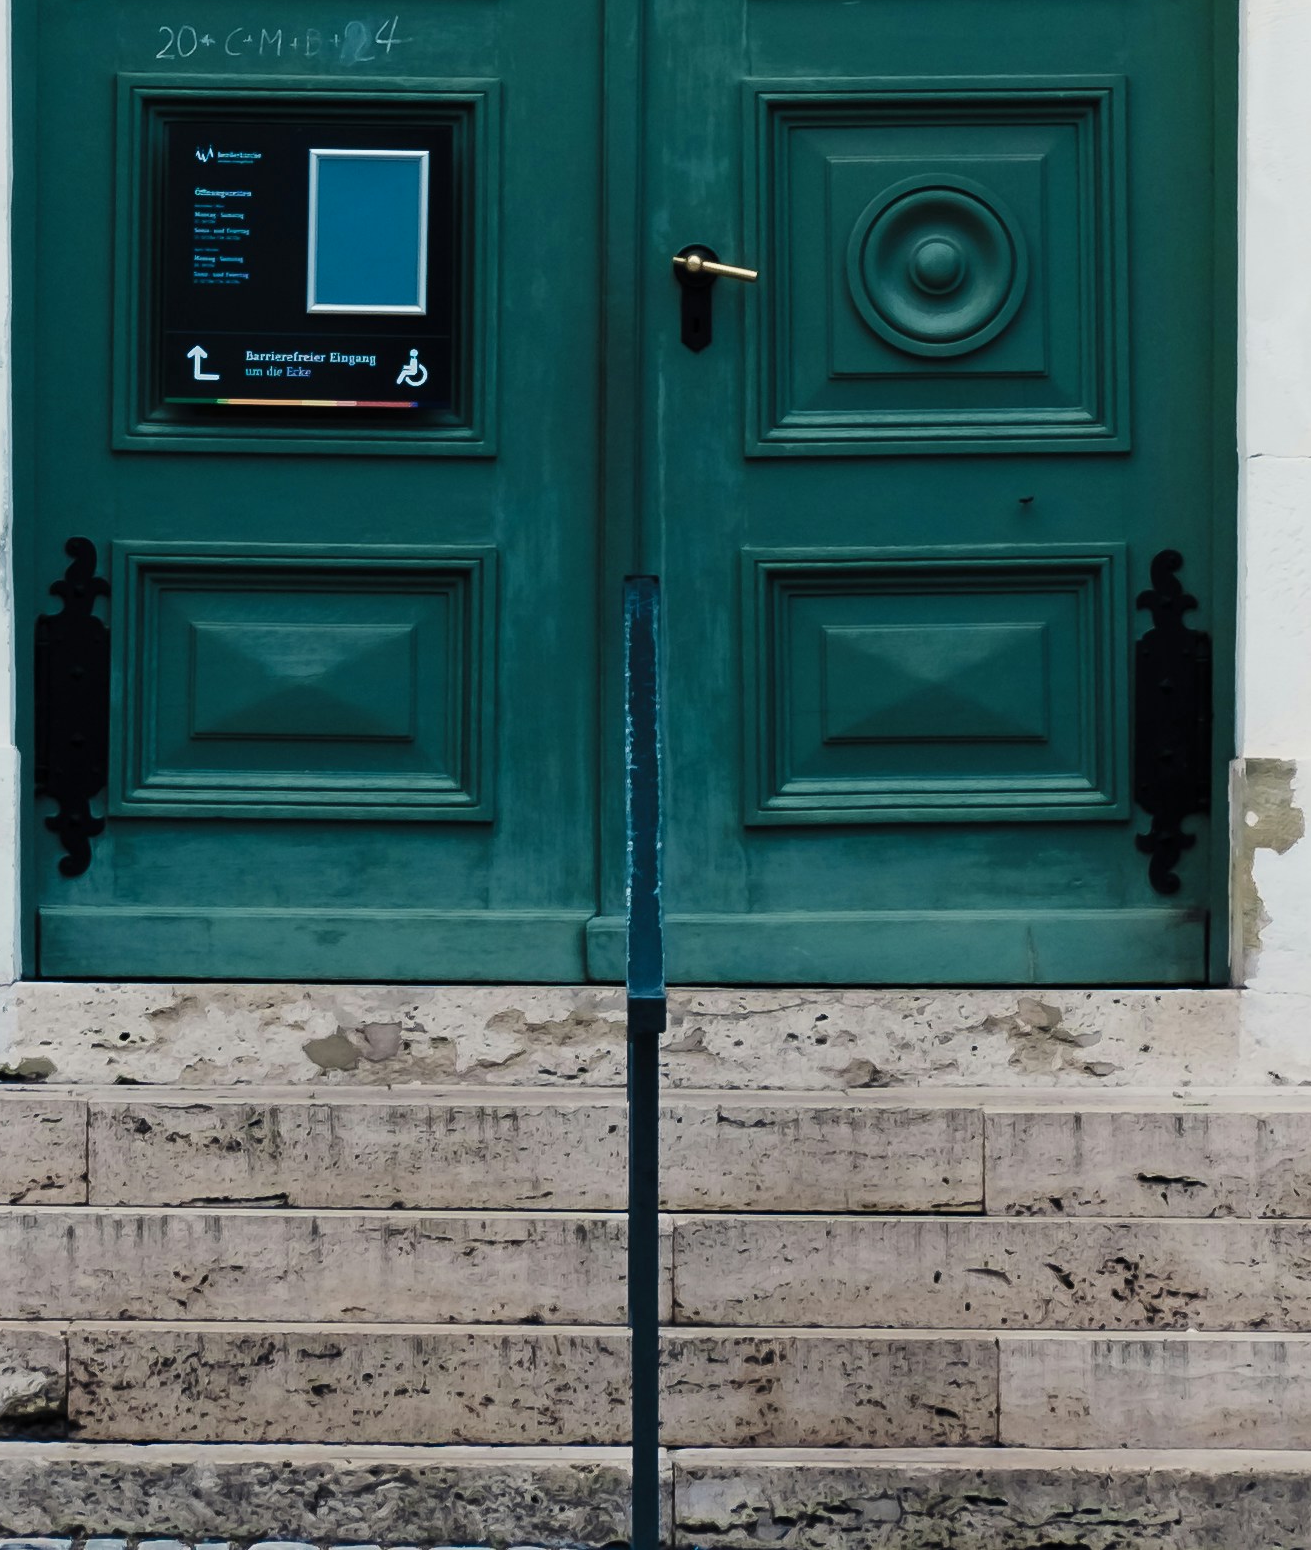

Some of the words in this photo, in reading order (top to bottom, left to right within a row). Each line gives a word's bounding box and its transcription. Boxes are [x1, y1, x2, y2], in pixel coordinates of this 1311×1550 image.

[246, 351, 326, 363] Barrierefreier
[330, 352, 376, 366] Eingang
[246, 368, 263, 376] um
[267, 366, 283, 377] die
[286, 367, 312, 377] Ecke
